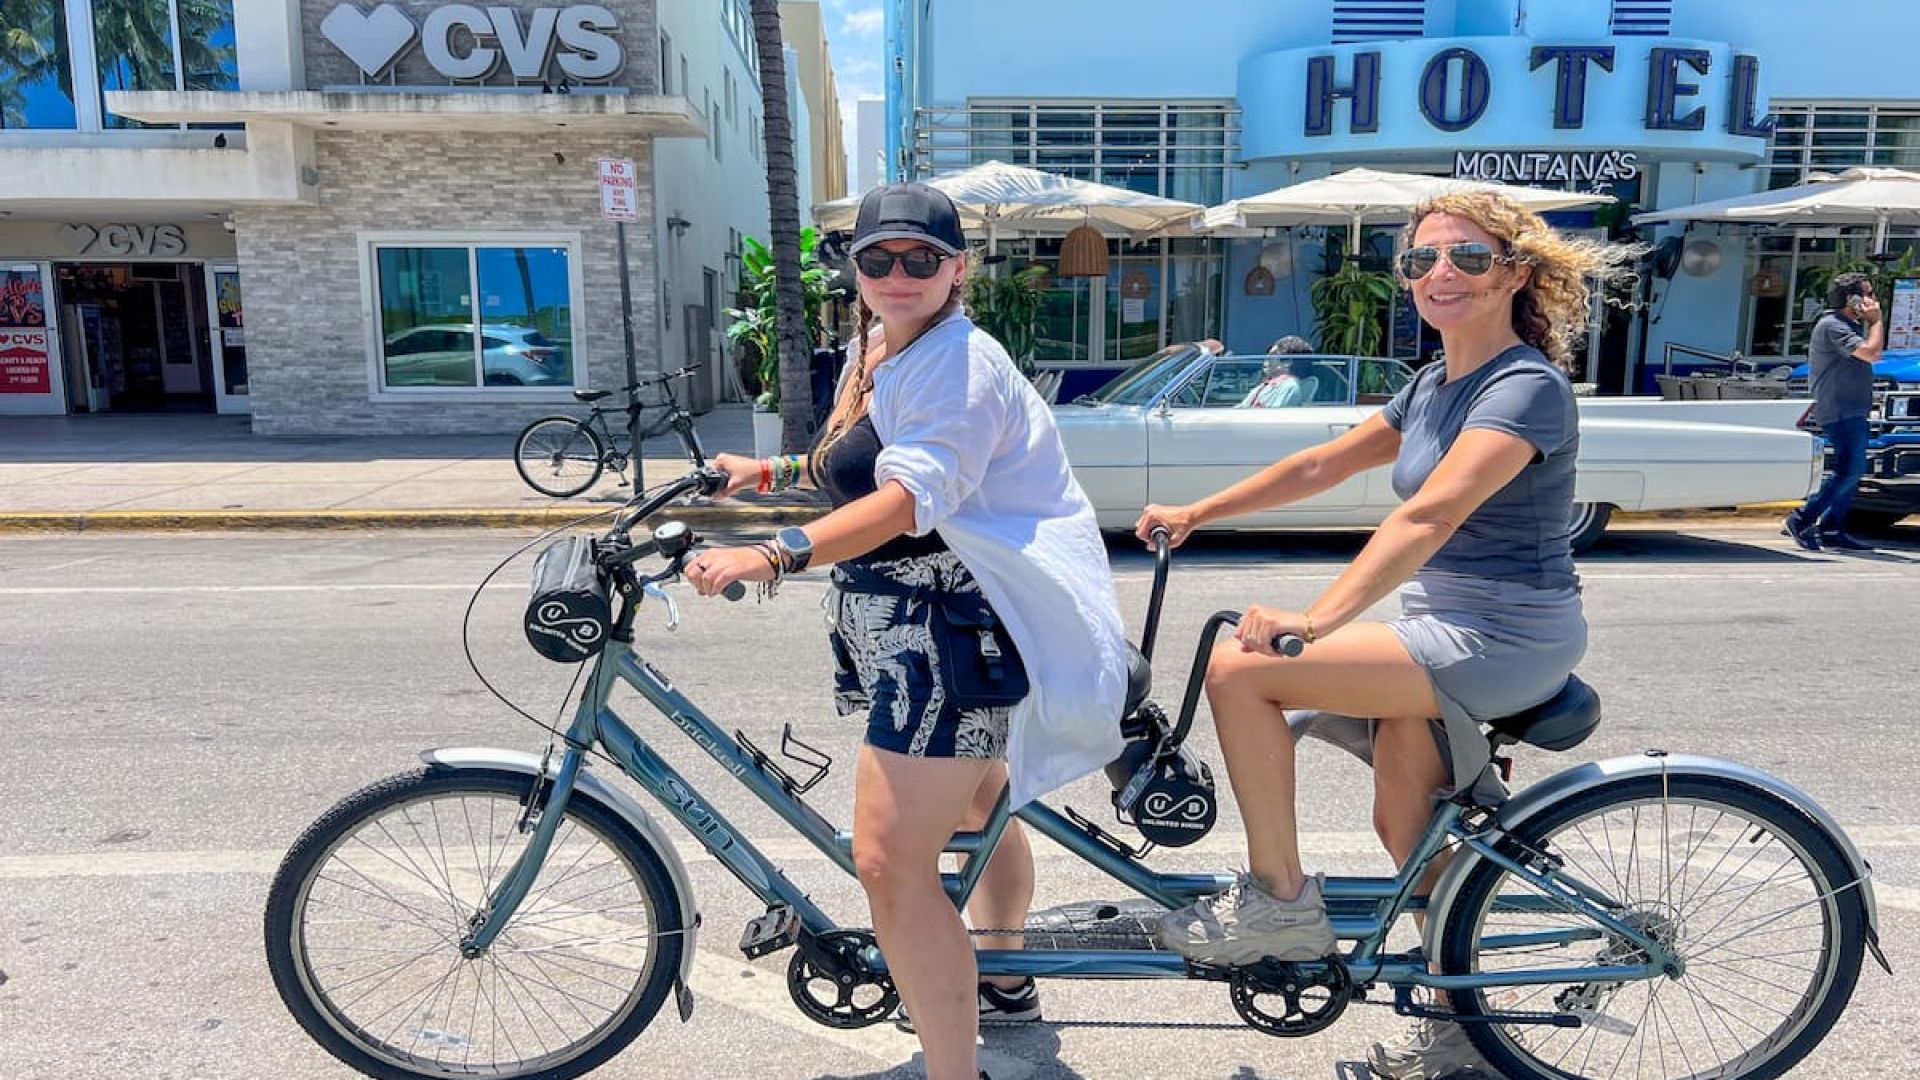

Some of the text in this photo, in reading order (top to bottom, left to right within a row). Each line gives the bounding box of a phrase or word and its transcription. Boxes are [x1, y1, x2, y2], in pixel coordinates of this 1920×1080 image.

[422, 4, 623, 80] CVS
[1303, 45, 1777, 137] HOTEL
[611, 163, 624, 174] NO
[1454, 150, 1638, 182] MONTANA'S
[602, 174, 633, 187] PARKING
[101, 223, 186, 255] CVS
[12, 334, 44, 344] CVS
[547, 607, 562, 619] U
[671, 709, 747, 777] brickell
[1153, 799, 1166, 810] U
